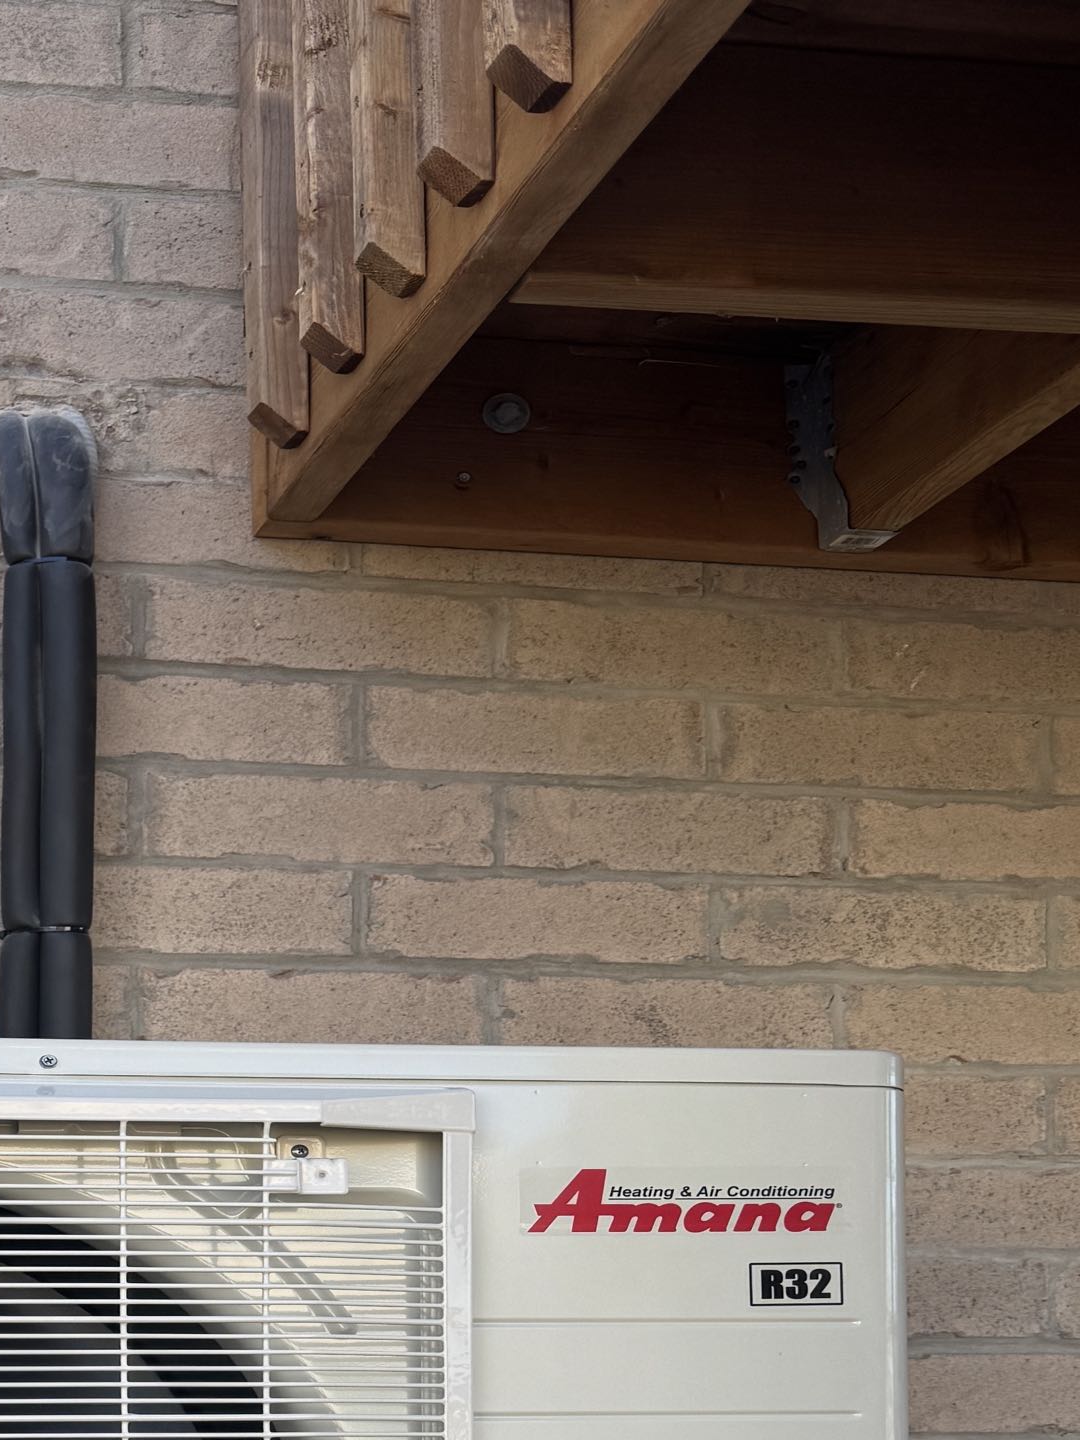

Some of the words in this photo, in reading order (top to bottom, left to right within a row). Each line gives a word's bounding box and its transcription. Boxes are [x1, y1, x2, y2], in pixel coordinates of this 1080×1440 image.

[527, 1168, 837, 1233] Amana
[609, 1185, 674, 1200] Heating
[680, 1186, 692, 1198] &
[696, 1185, 723, 1198] Air
[726, 1185, 836, 1200] Conditioning
[760, 1268, 832, 1300] R32
